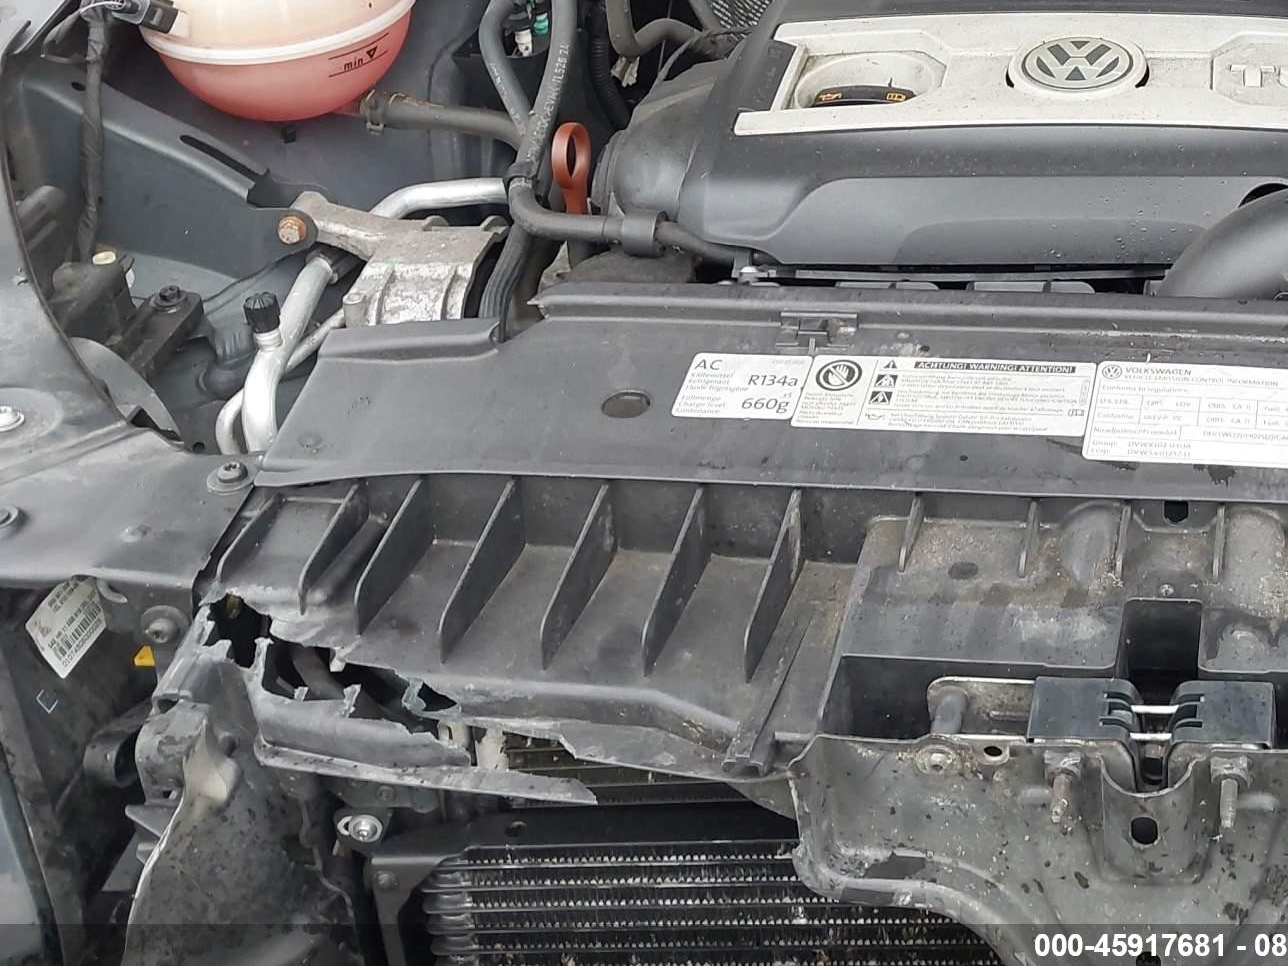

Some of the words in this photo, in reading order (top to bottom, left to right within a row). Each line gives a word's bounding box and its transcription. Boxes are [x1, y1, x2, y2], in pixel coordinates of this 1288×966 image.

[344, 57, 364, 71] min
[694, 359, 723, 371] AC
[918, 362, 967, 371] ACHTUNG!
[969, 363, 1018, 372] WARNING!
[1018, 365, 1074, 374] ATTENTION!
[1125, 366, 1192, 376] VOLKSWAGEN
[747, 374, 799, 387] R134a
[741, 397, 790, 414] 660g
